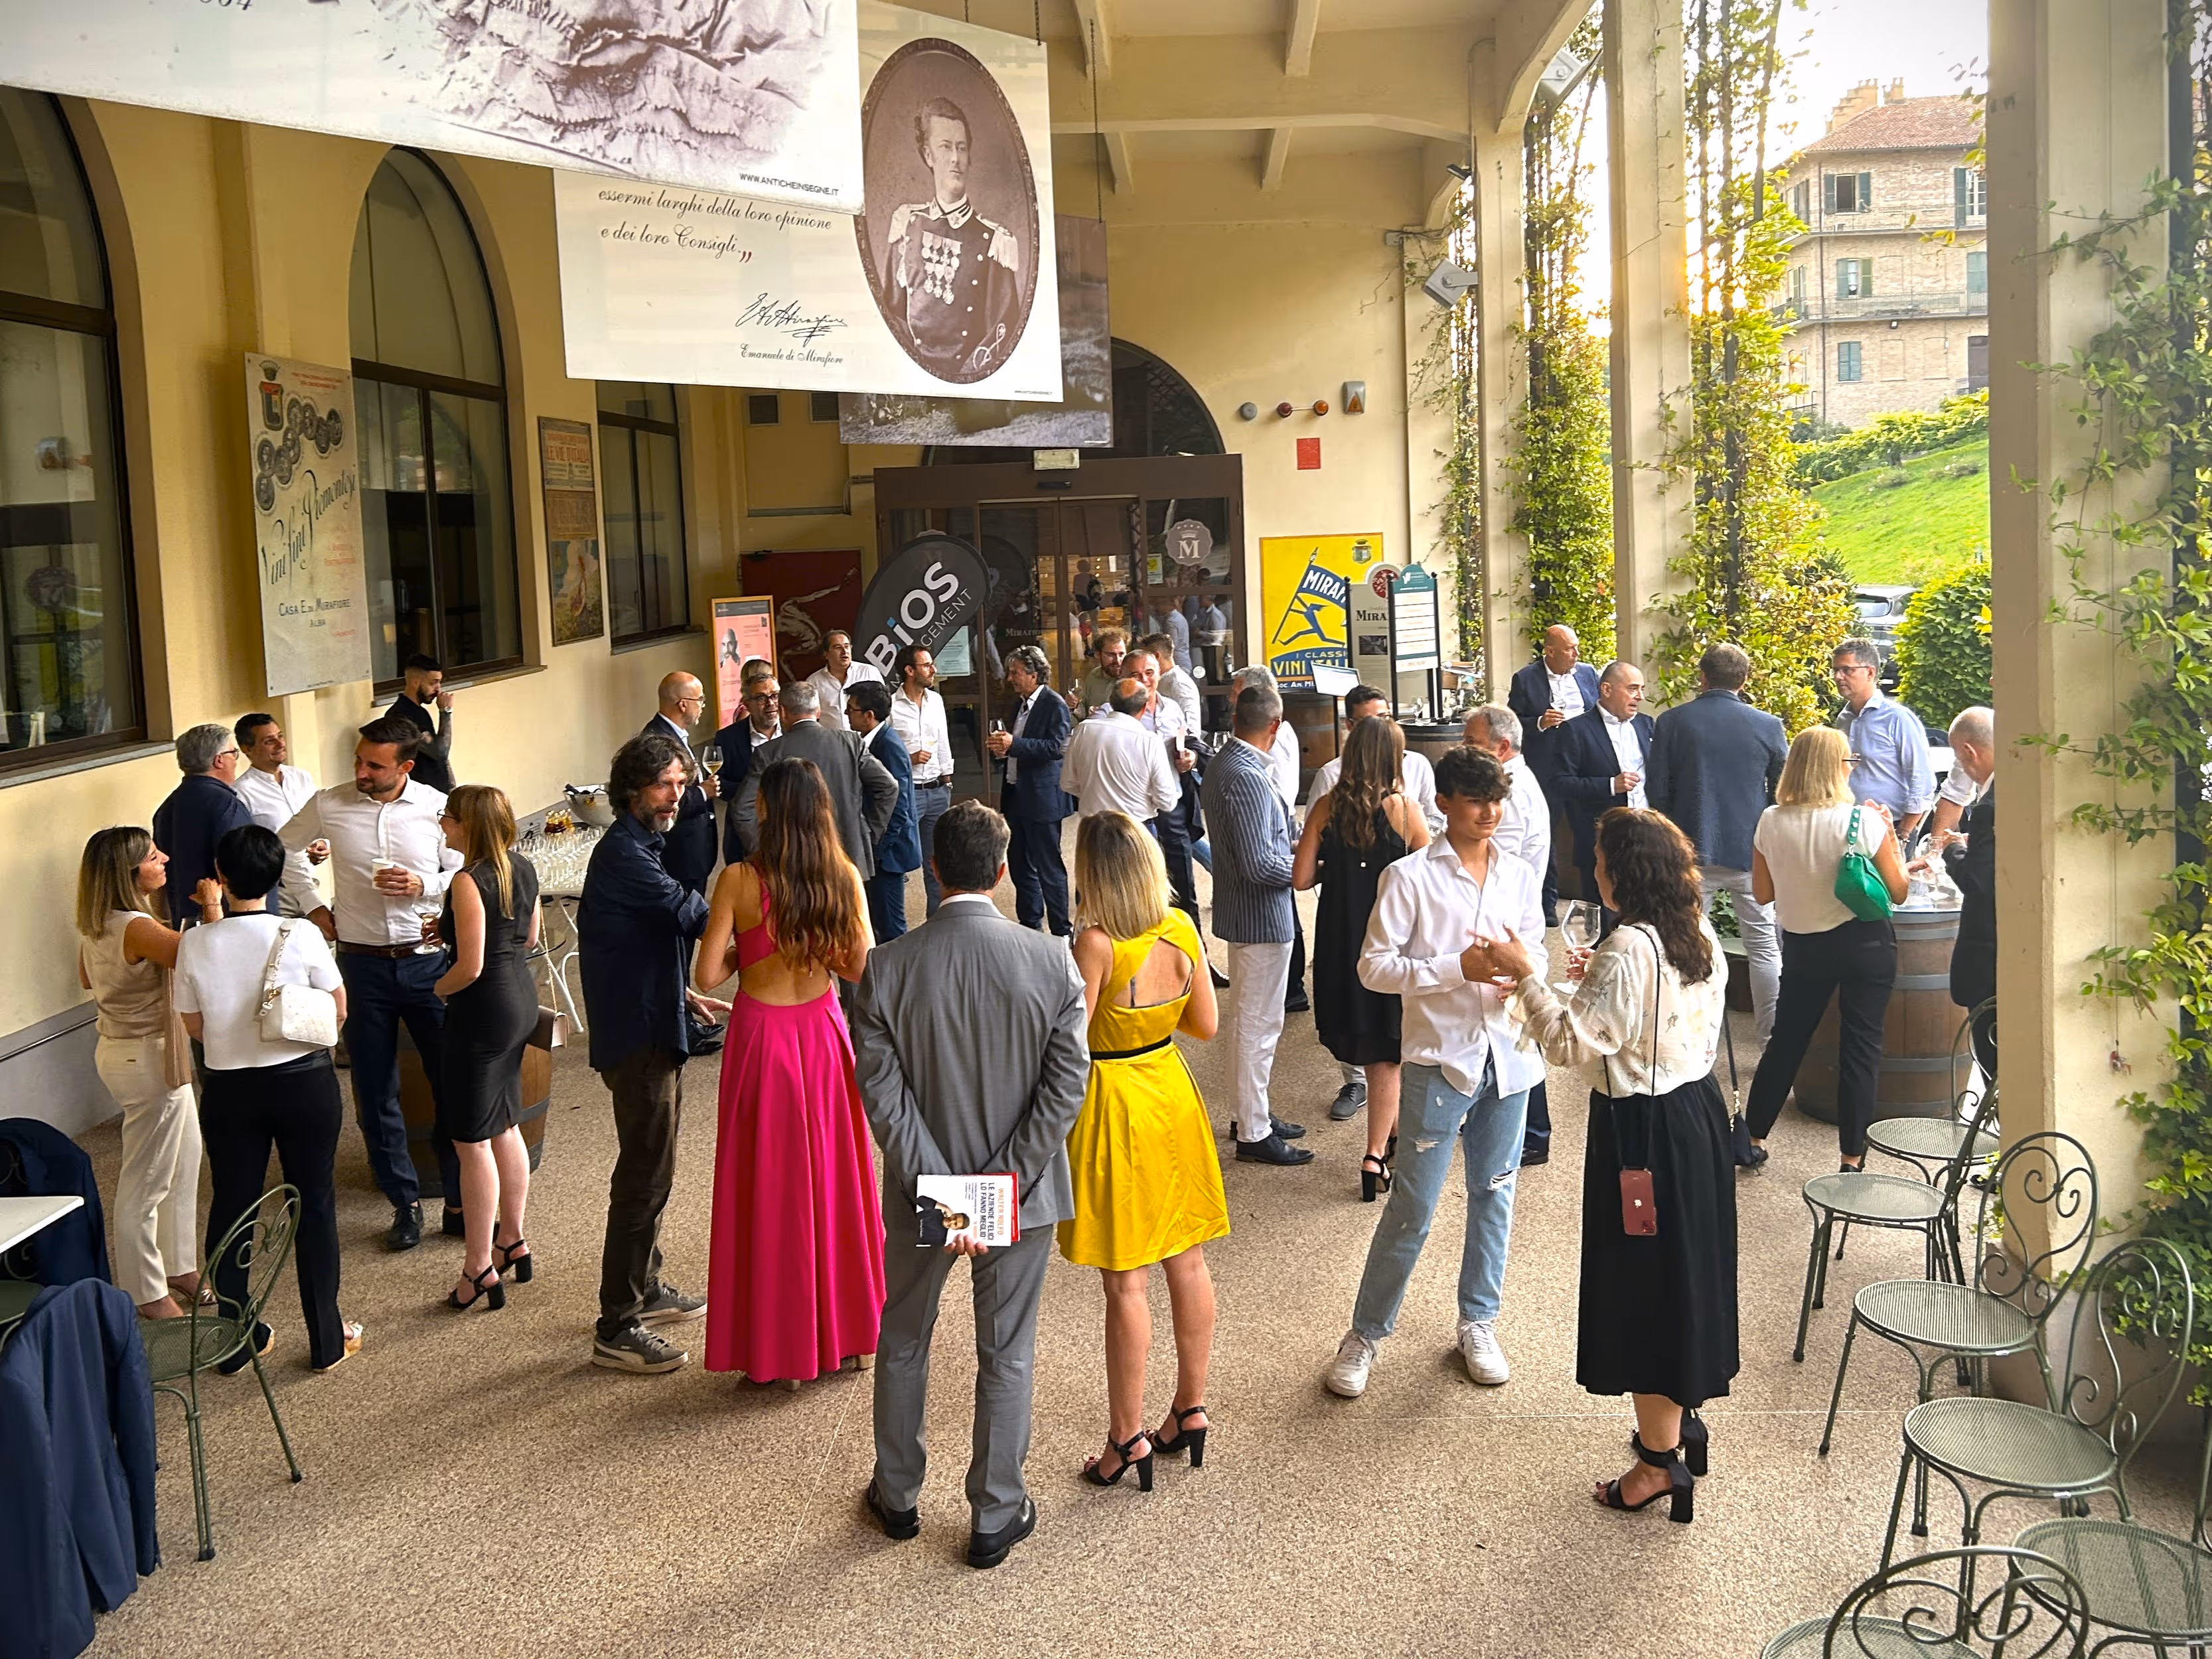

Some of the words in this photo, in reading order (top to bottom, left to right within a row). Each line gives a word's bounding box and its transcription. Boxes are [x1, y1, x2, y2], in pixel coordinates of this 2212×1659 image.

[739, 173, 839, 196] WWW.ANTICHEINSEGNE.IT
[599, 190, 654, 206] essermi
[657, 190, 703, 219] larghi
[707, 196, 741, 218] della
[745, 202, 773, 222] loro
[775, 211, 832, 231] opinione
[601, 228, 610, 238] e
[613, 221, 636, 241] dei
[640, 224, 670, 244] loro
[741, 343, 784, 360] Emanuele
[786, 349, 795, 360] di
[797, 349, 844, 367] Mirafiore
[1302, 569, 1346, 603] MIRAF
[1356, 610, 1389, 622] MIRA
[1273, 660, 1306, 676] VINI
[980, 1182, 987, 1190] LO
[988, 1182, 995, 1190] LE
